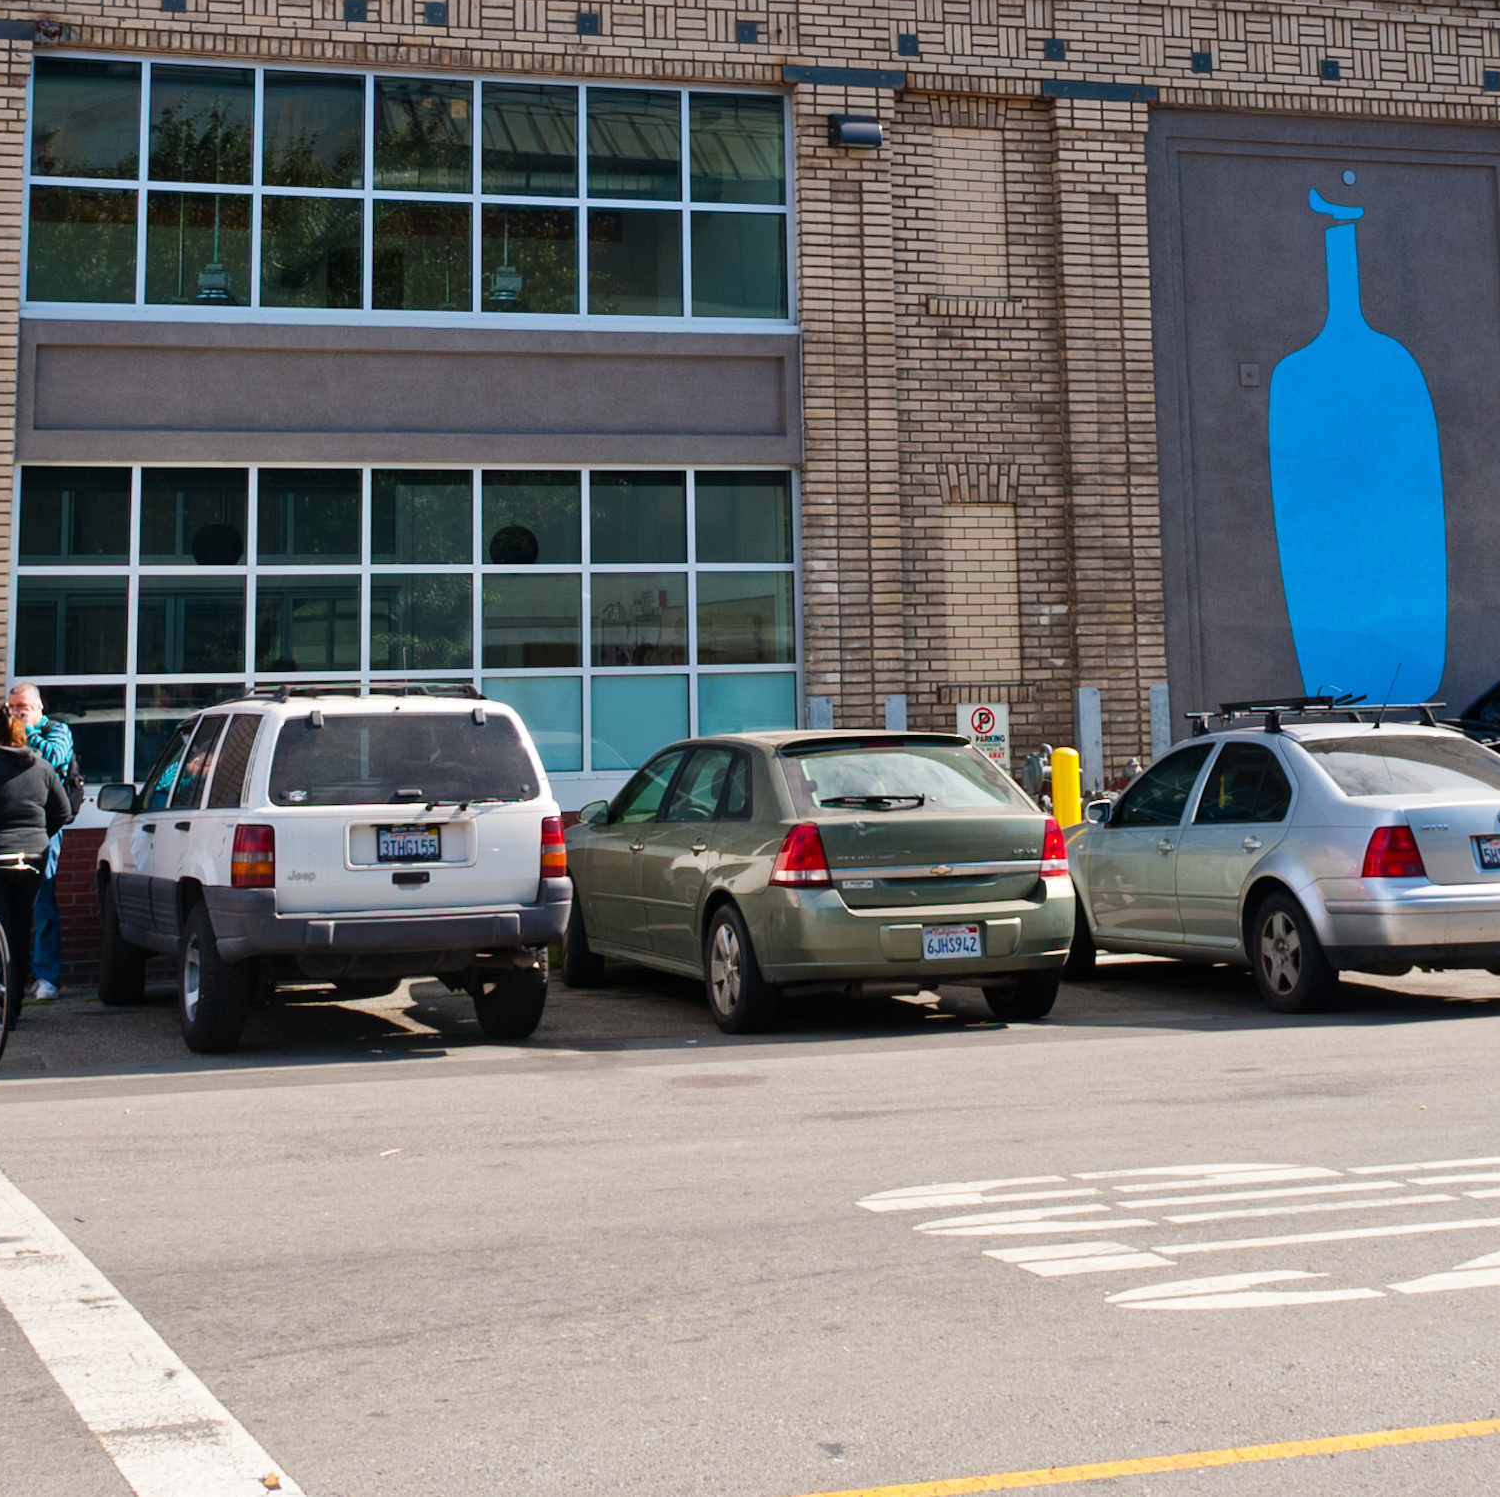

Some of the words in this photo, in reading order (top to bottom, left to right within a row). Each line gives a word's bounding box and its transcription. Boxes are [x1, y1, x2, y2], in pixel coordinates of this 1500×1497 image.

[975, 734, 1006, 743] PARKING
[382, 839, 437, 856] 3THG155
[287, 870, 316, 883] Jeep
[927, 936, 978, 954] 6JHS942
